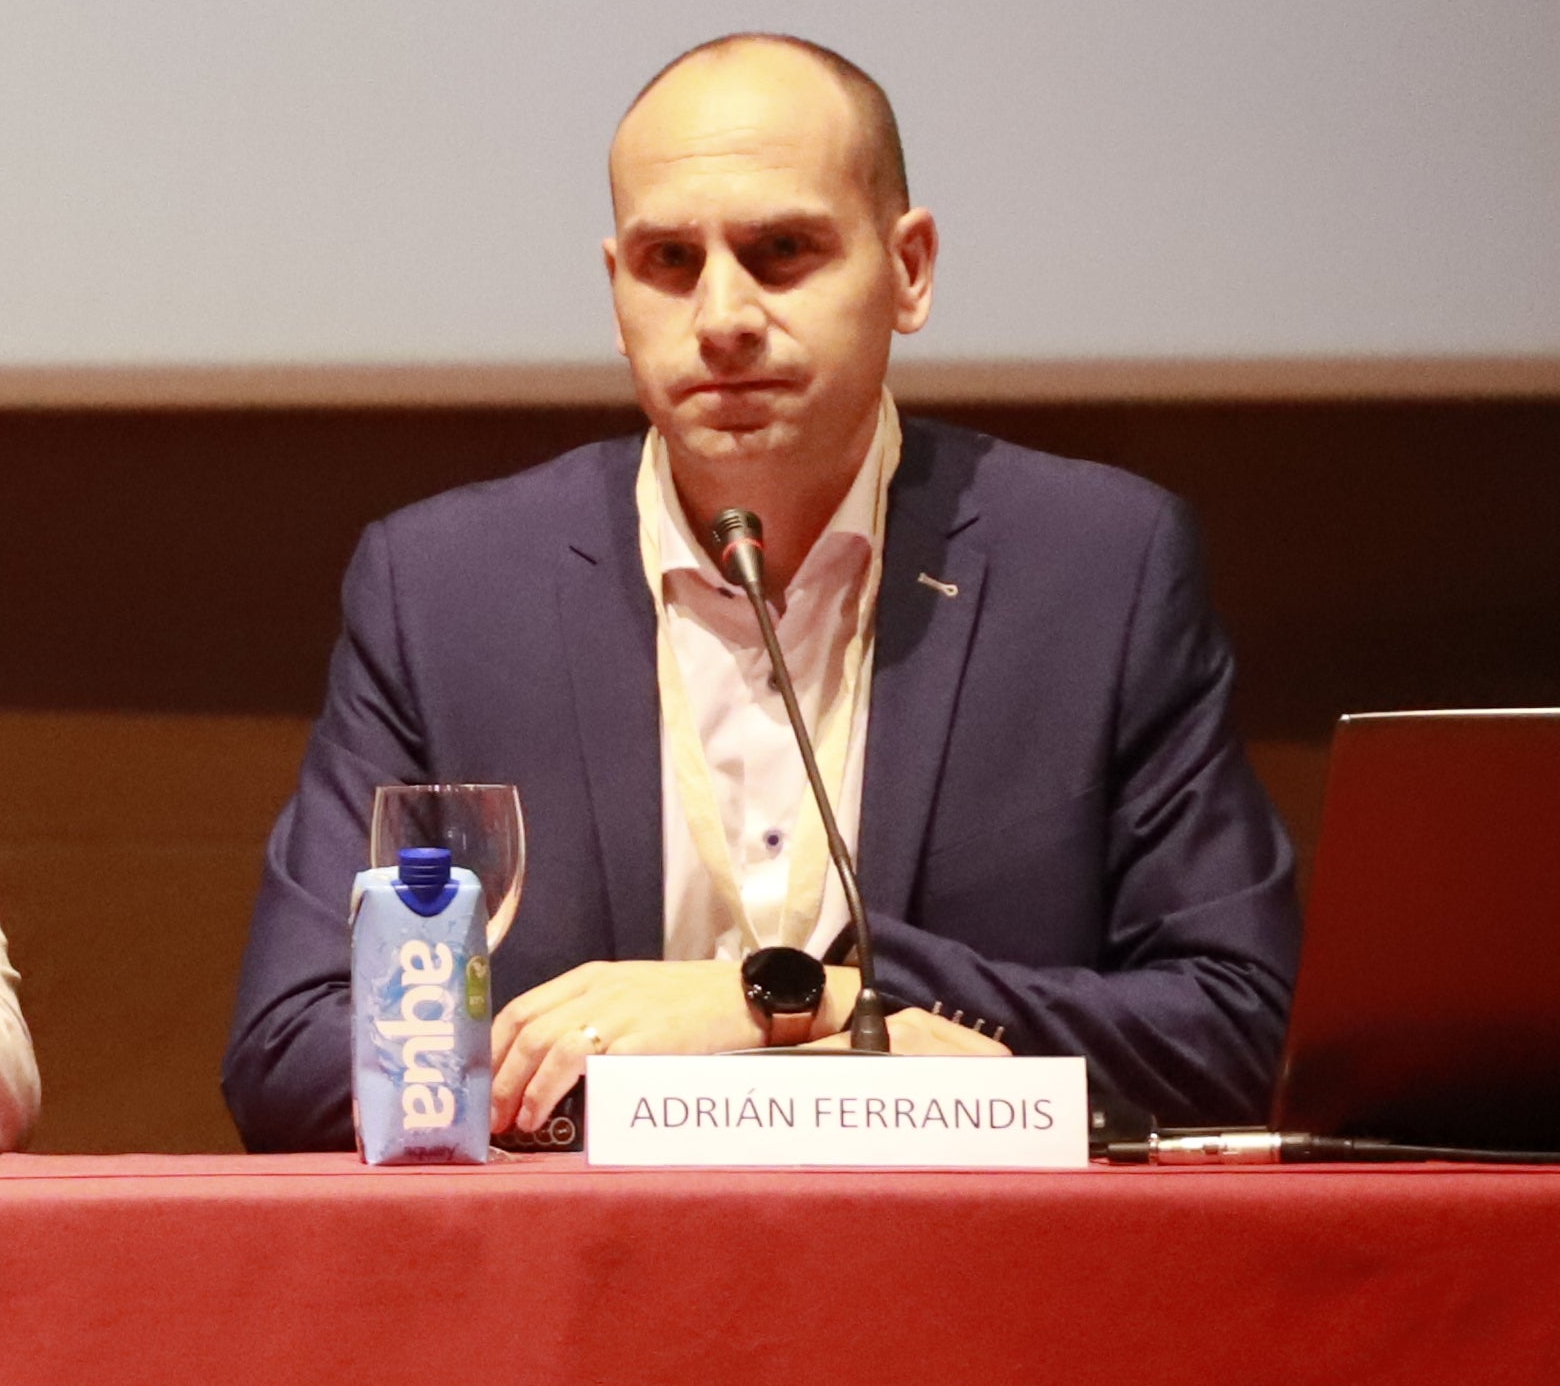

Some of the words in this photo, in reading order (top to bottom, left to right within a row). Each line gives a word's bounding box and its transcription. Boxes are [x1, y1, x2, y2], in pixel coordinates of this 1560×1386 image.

[376, 939, 456, 1131] aqua
[629, 1088, 795, 1129] ADRIÁN
[814, 1097, 1055, 1131] FERRANDIS
